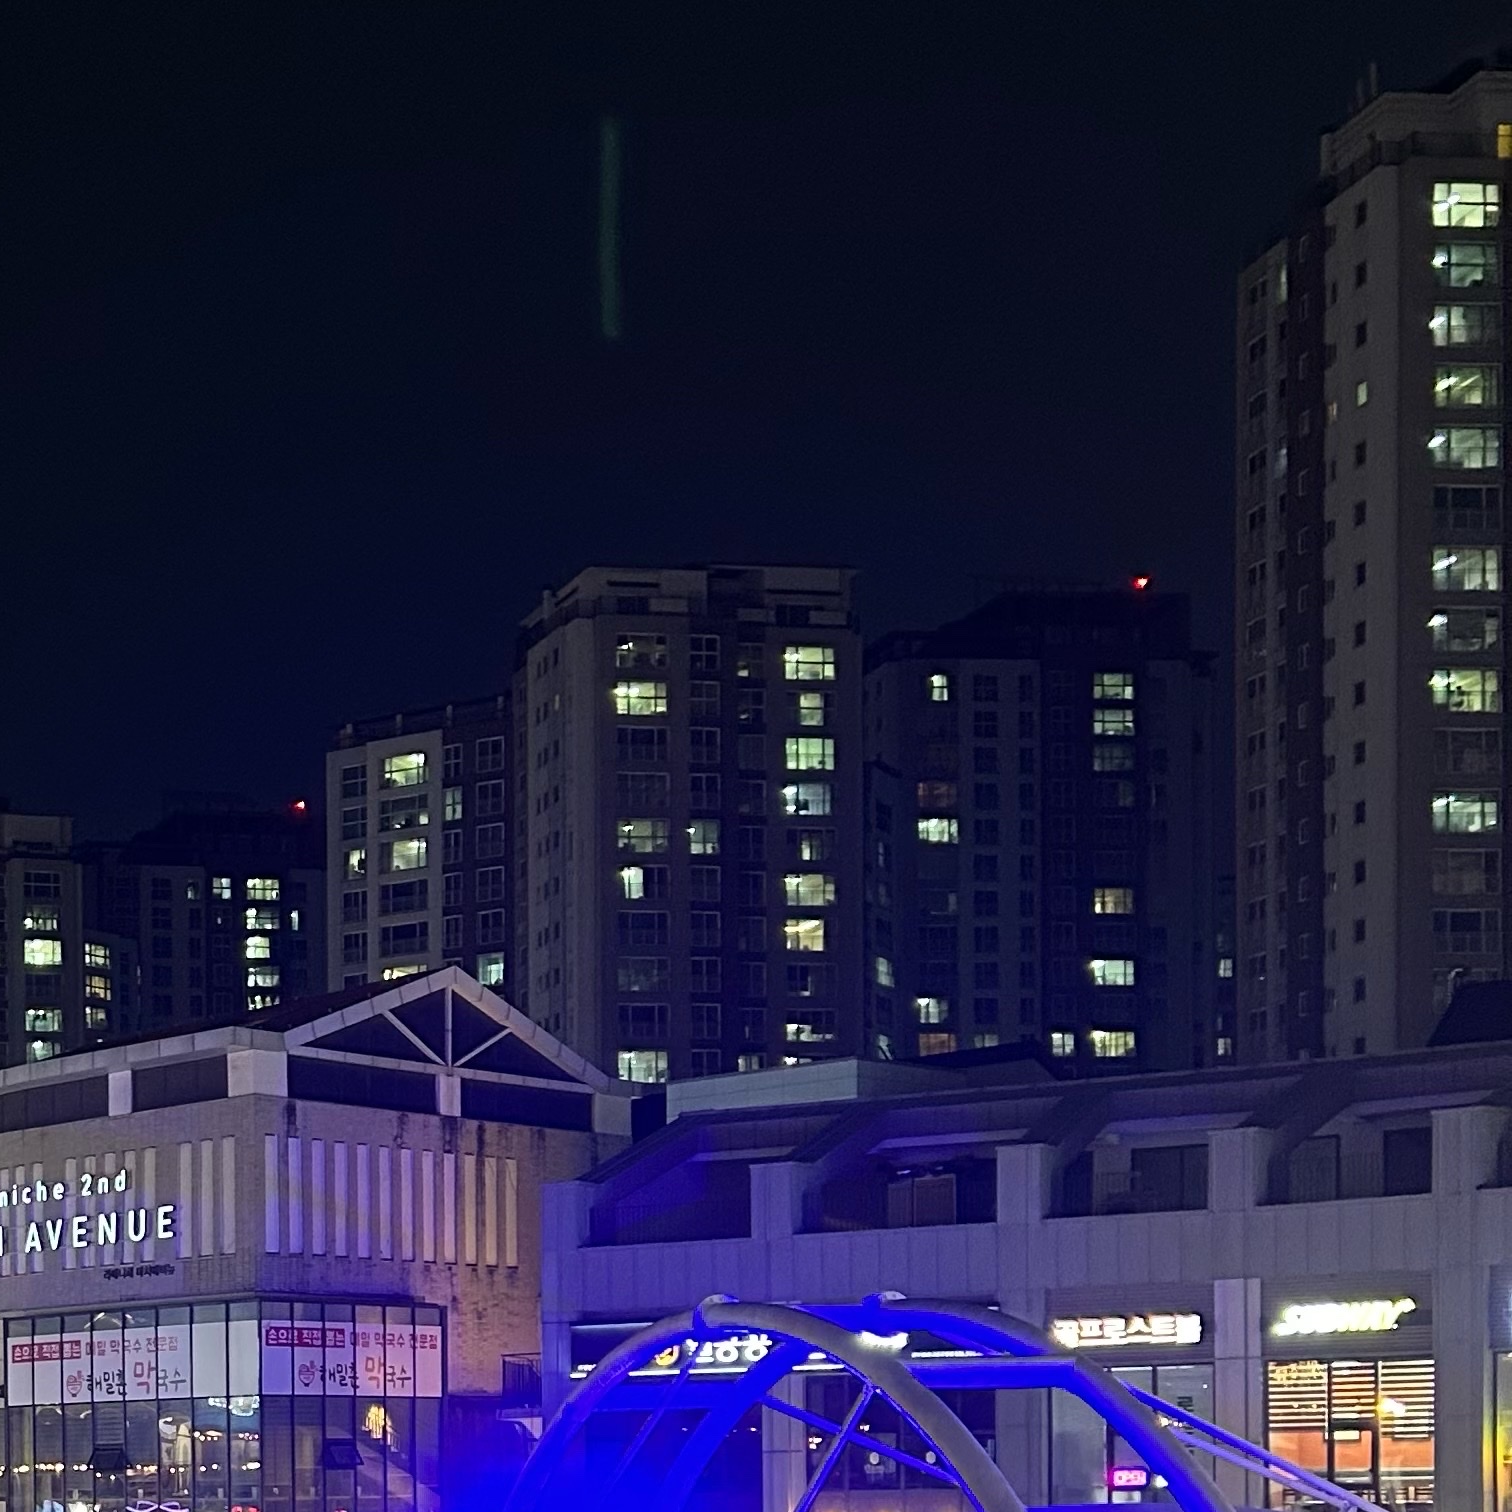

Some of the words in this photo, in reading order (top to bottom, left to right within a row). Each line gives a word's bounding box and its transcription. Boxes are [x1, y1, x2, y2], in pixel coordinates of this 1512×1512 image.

[80, 1169, 128, 1196] 2nd
[25, 1204, 175, 1253] AVENUE
[133, 1359, 187, 1395] 막국수
[365, 1357, 411, 1388] 막국수
